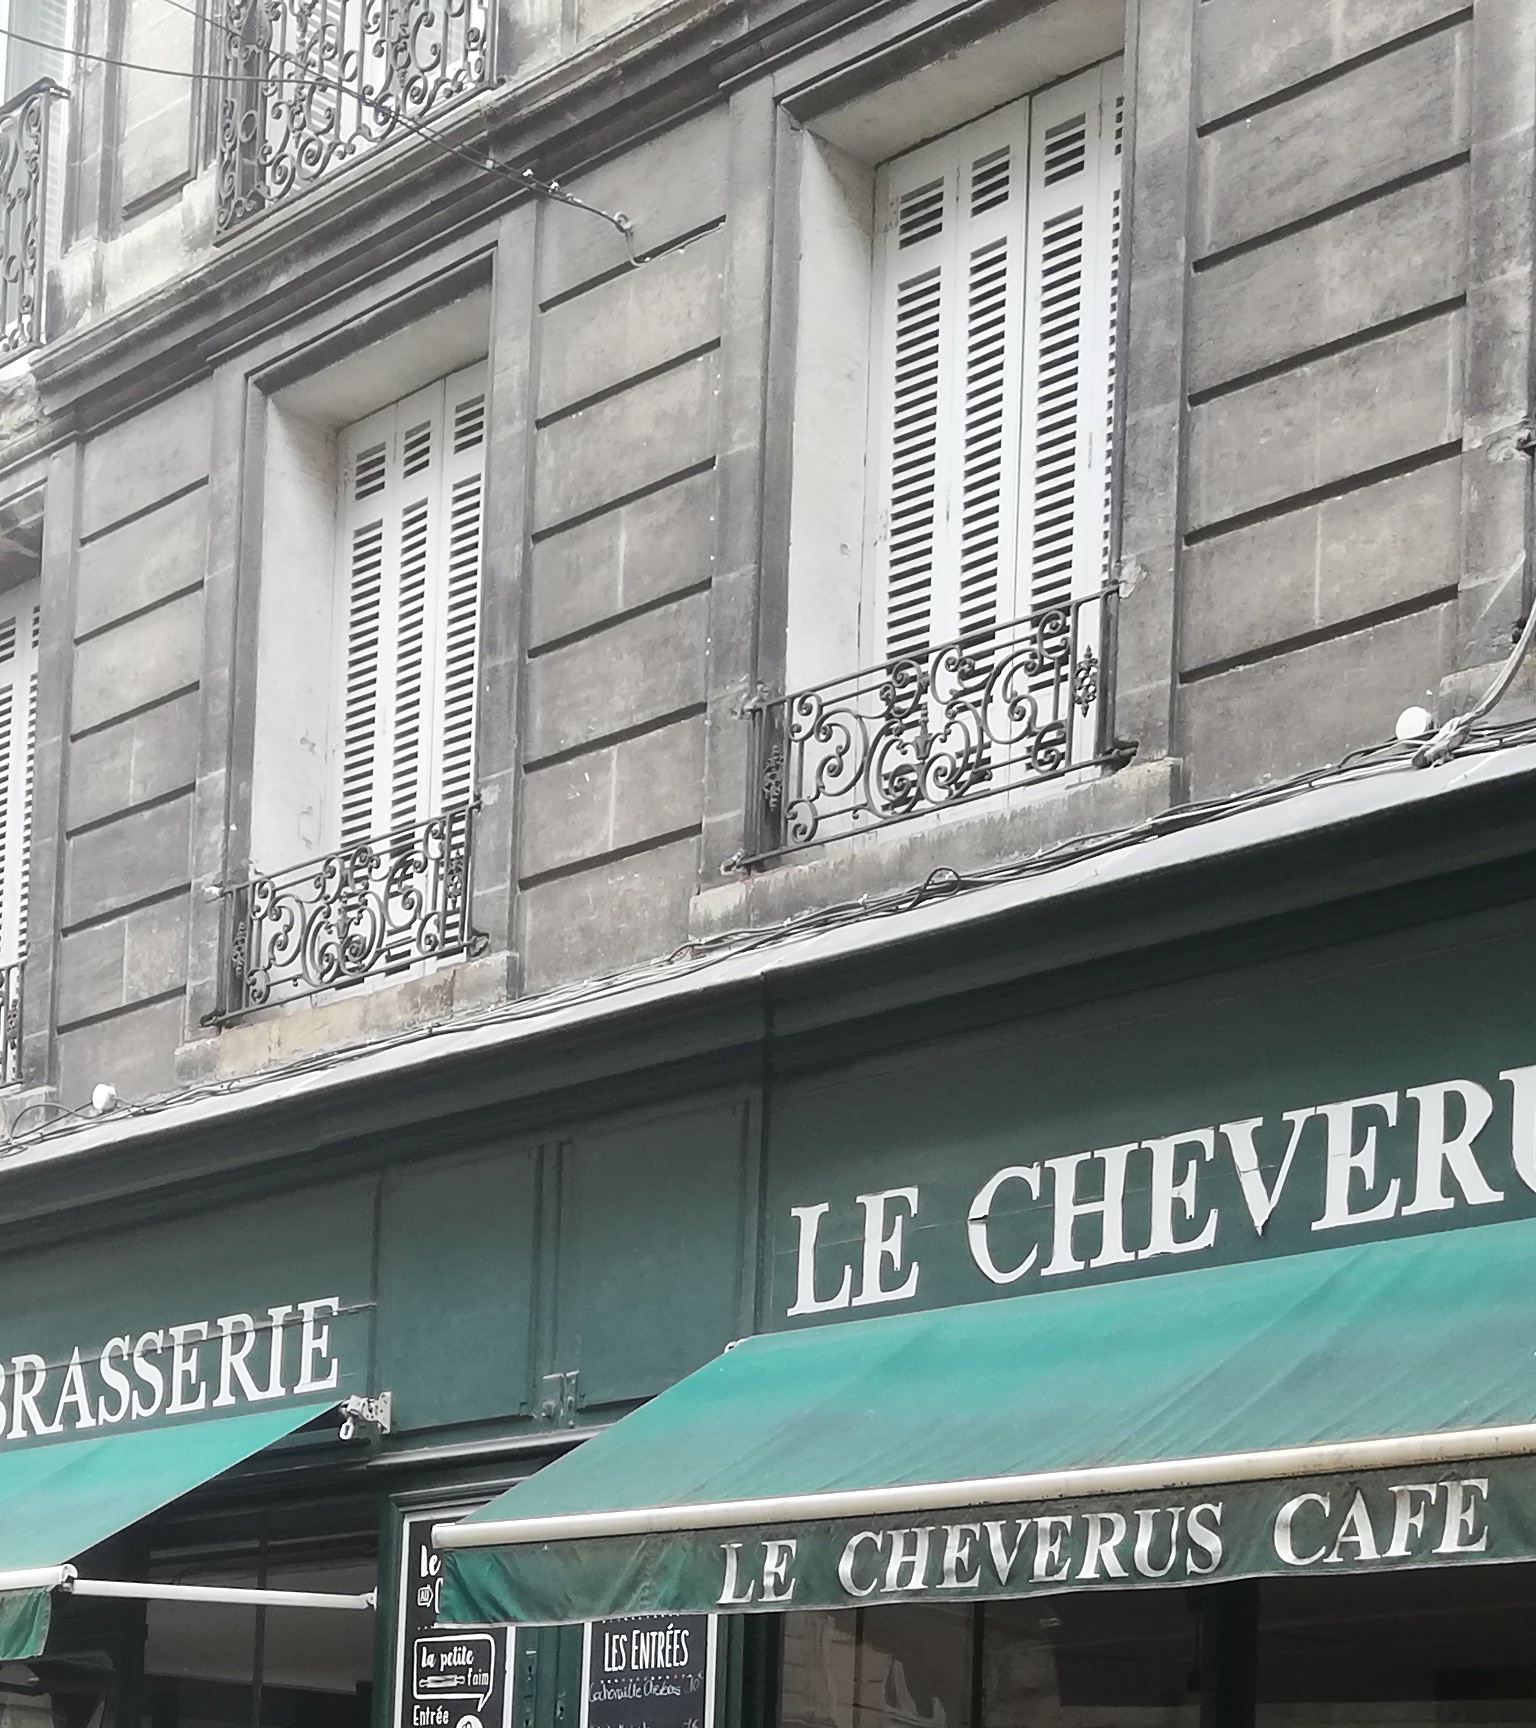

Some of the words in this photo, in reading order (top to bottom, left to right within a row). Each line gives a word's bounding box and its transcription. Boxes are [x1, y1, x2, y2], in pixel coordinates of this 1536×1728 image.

[787, 1187, 920, 1318] LE
[717, 1540, 798, 1605] LE
[837, 1502, 1225, 1598] CHEVERUS
[1274, 1478, 1490, 1565] CAFE
[440, 1645, 475, 1672] petite
[604, 1632, 627, 1672] LES
[467, 1667, 489, 1686] faim
[412, 1705, 449, 1726] Entrée
